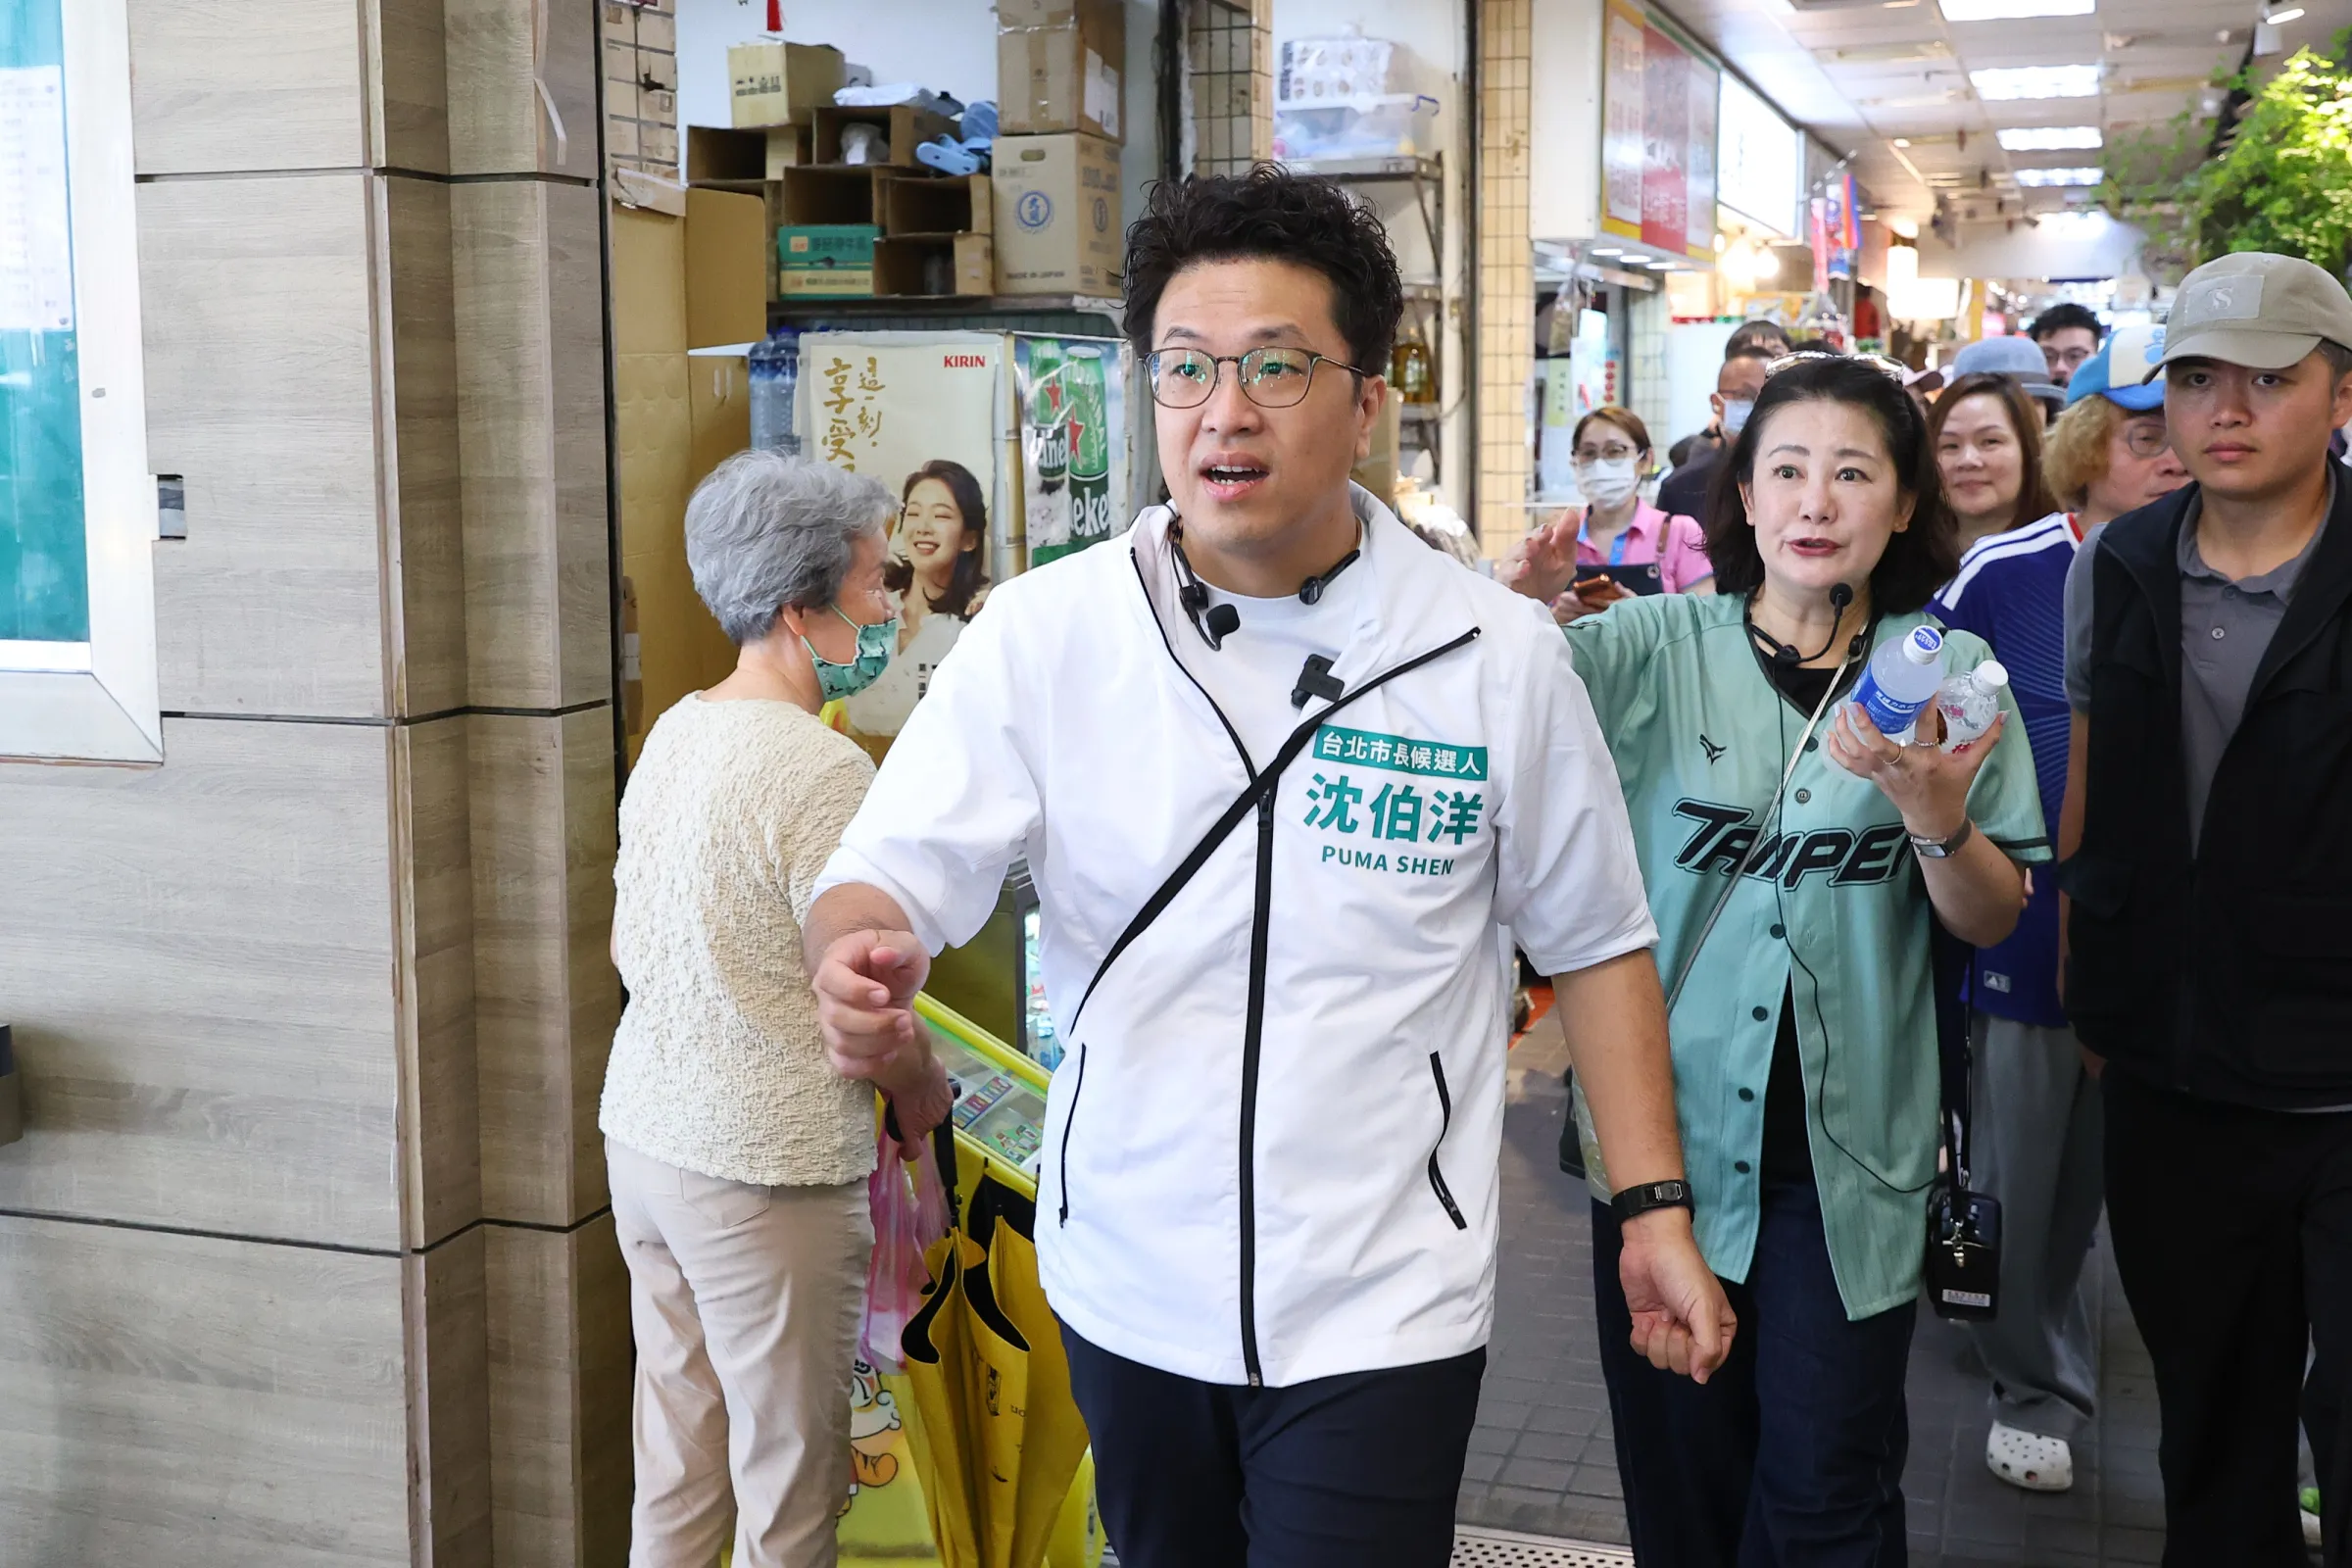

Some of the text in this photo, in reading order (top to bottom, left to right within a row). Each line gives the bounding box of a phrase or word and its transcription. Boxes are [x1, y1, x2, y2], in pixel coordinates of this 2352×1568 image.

[943, 355, 986, 368] KIRIN
[821, 357, 857, 473] 享受
[1322, 731, 1481, 776] 台北市長候選人
[1303, 772, 1484, 846] 沈伯洋
[1322, 845, 1455, 876] PUMA SHEN
